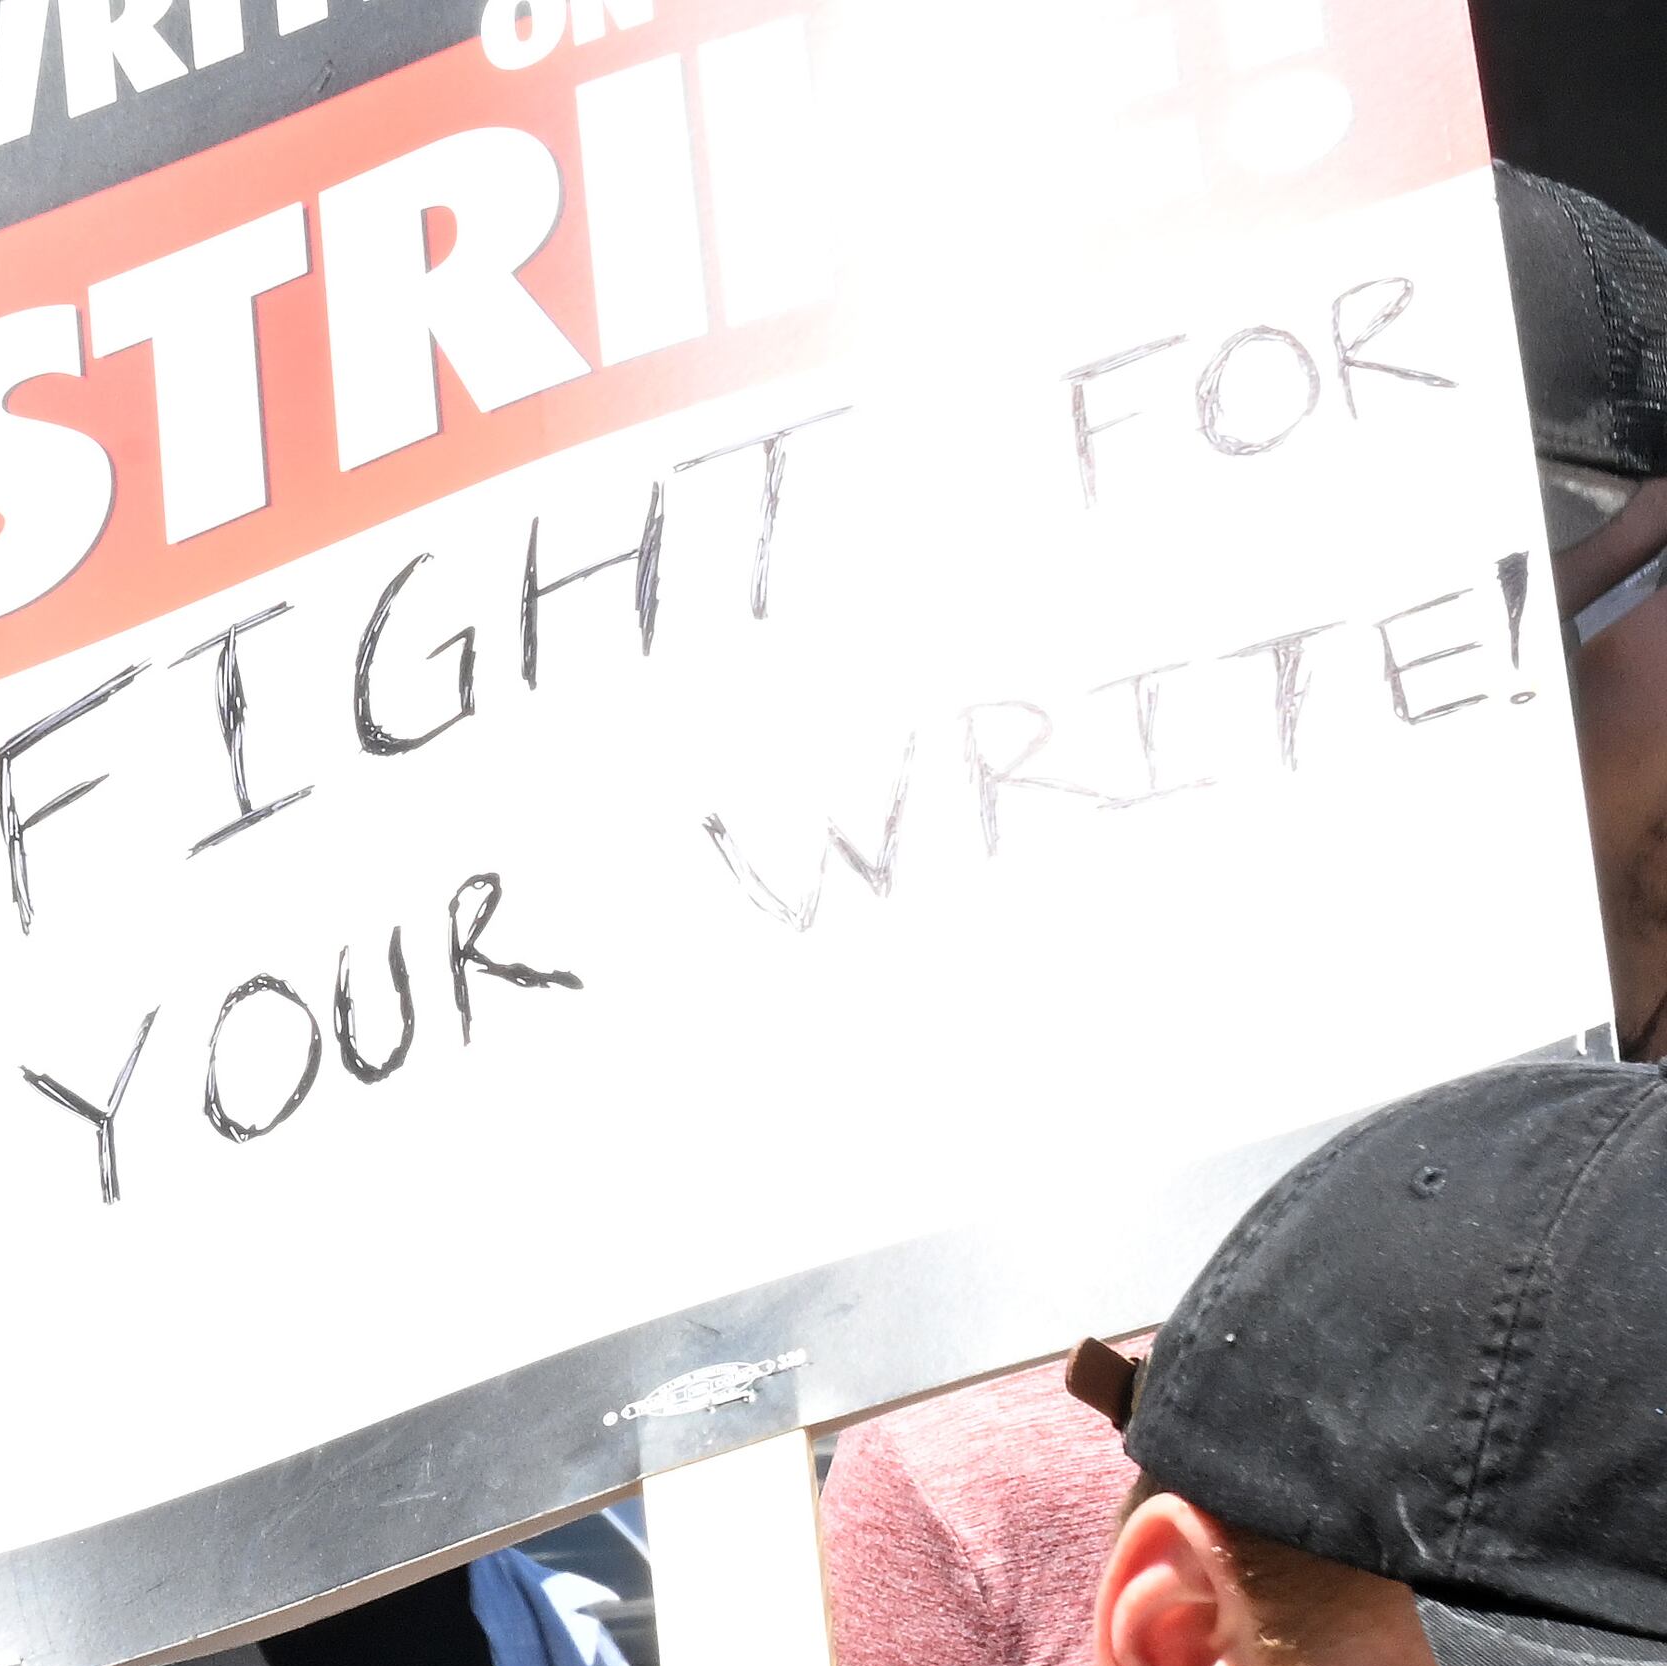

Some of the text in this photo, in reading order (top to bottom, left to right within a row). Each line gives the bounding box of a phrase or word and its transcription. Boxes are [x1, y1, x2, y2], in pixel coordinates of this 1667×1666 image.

[1061, 276, 1460, 511] FOR
[701, 550, 1538, 933] WRITE!
[18, 871, 586, 1206] YOUR
